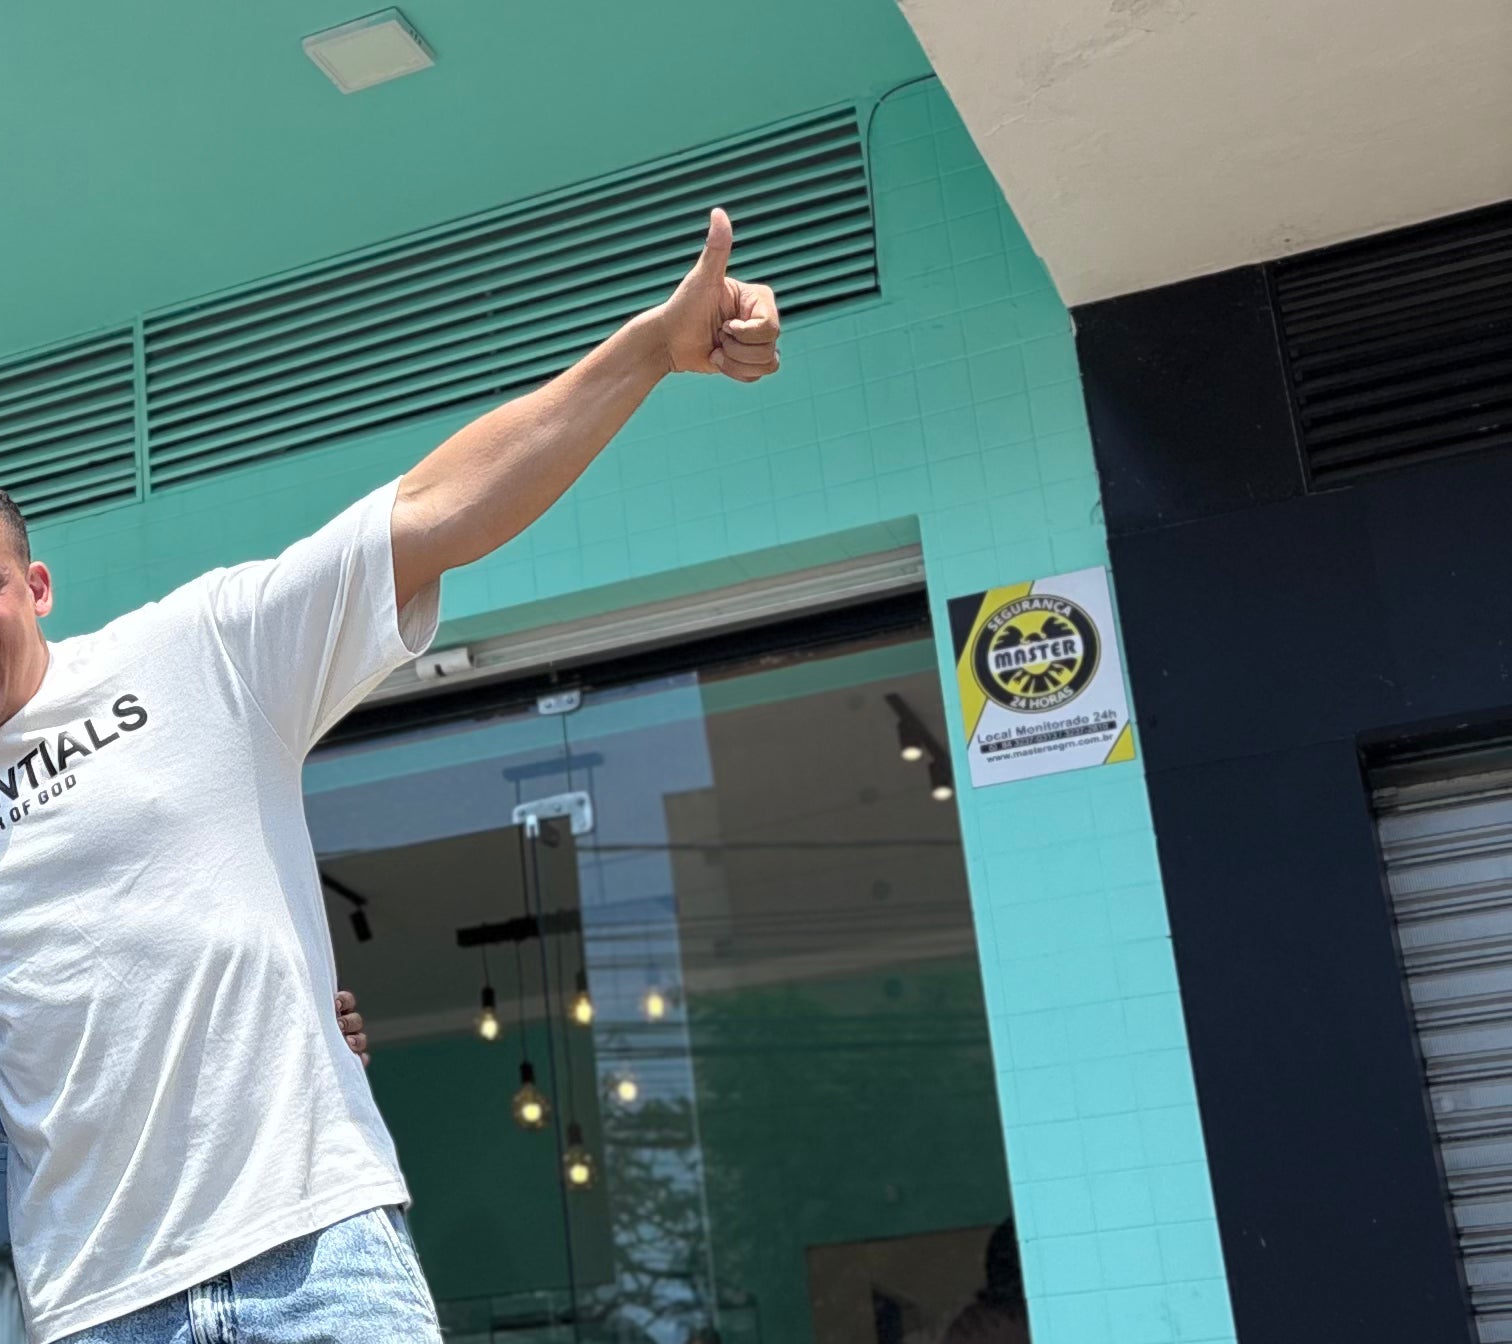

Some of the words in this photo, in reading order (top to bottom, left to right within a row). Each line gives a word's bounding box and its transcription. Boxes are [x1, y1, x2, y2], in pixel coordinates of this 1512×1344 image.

[988, 599, 1072, 632] SEGURANÇA
[994, 639, 1077, 669] MASTER
[1010, 696, 1026, 709] 24
[1029, 686, 1074, 709] HORAS
[977, 728, 1012, 744] Local
[1015, 715, 1090, 736] Monitorado
[1093, 709, 1117, 722] 24h
[9, 799, 32, 823] OF
[38, 774, 77, 805] GOD
